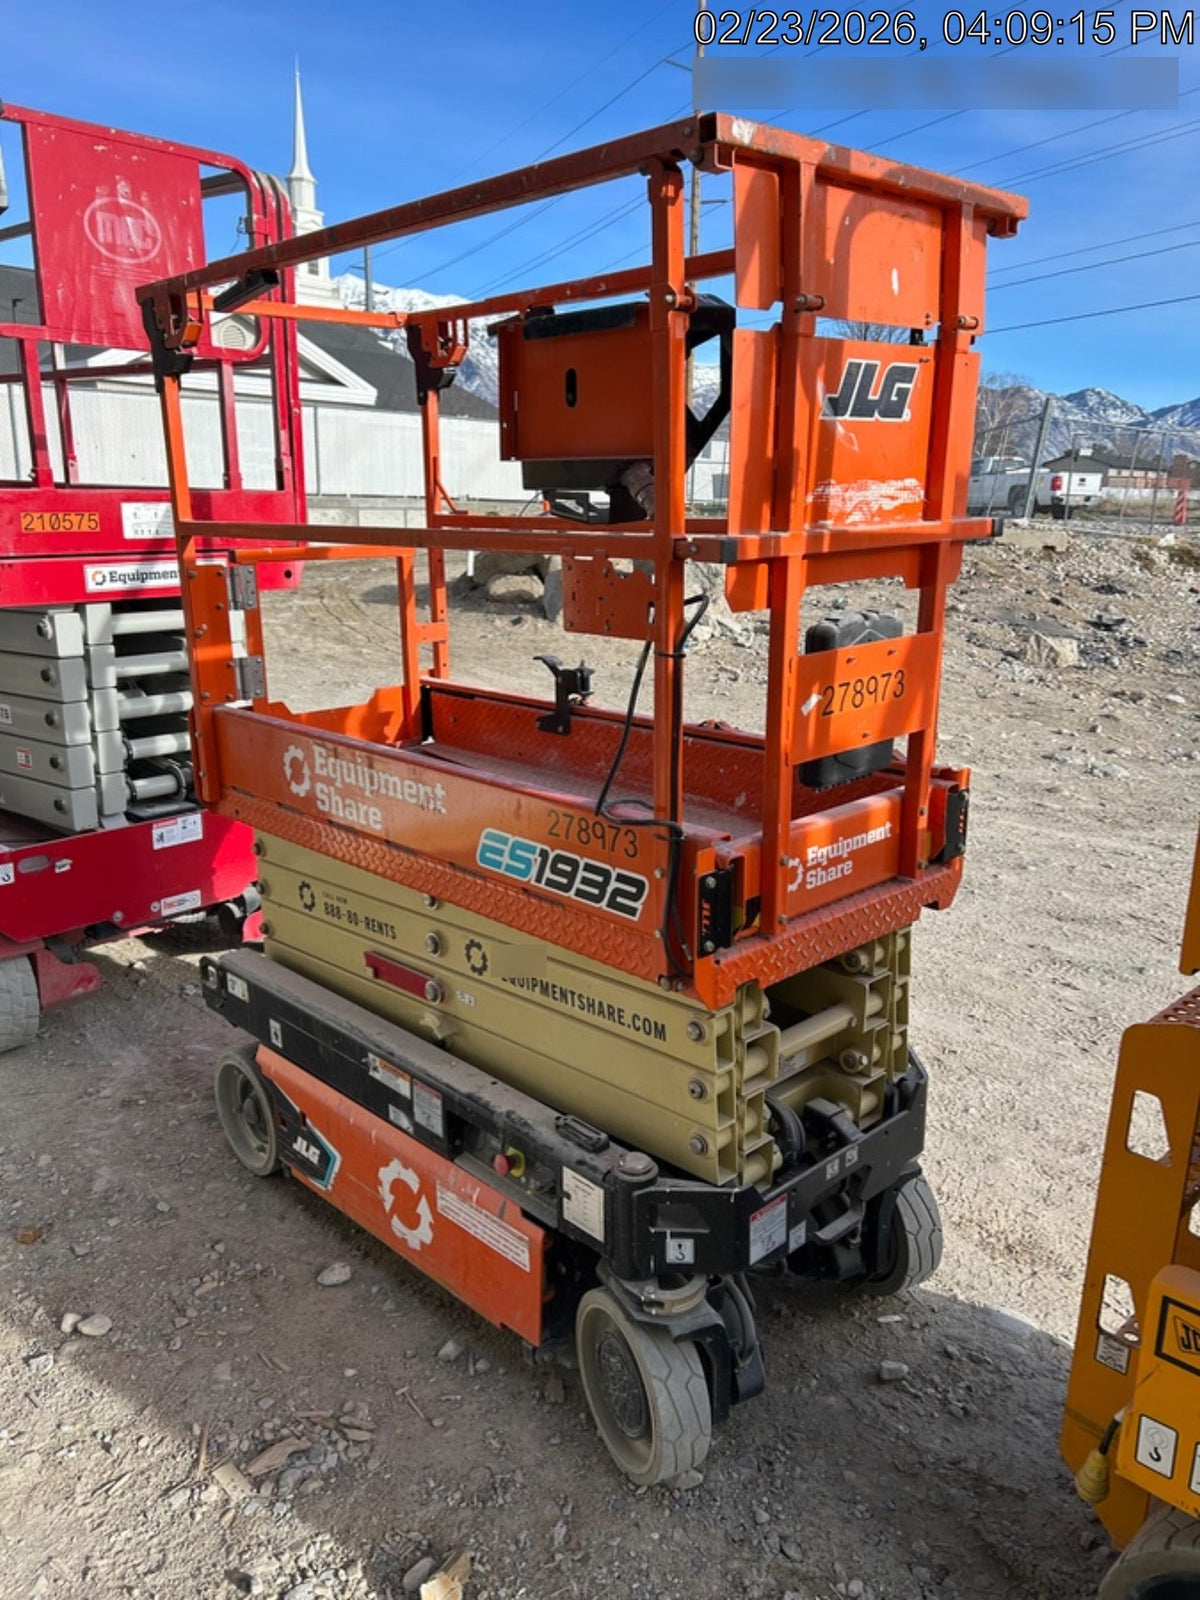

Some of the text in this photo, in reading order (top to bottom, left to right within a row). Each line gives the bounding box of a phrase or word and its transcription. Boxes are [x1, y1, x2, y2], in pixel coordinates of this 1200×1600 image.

[820, 358, 920, 422] JLG
[23, 513, 98, 532] 210575
[109, 569, 179, 584] Equipmen
[821, 669, 906, 717] 278973
[313, 745, 447, 814] Equipment
[315, 782, 383, 831] Share
[547, 809, 638, 858] 278973
[806, 821, 893, 867] Equipment
[477, 828, 649, 921] ES1932
[805, 859, 853, 890] Share
[501, 977, 667, 1042] UIPMENTSHARE.COM
